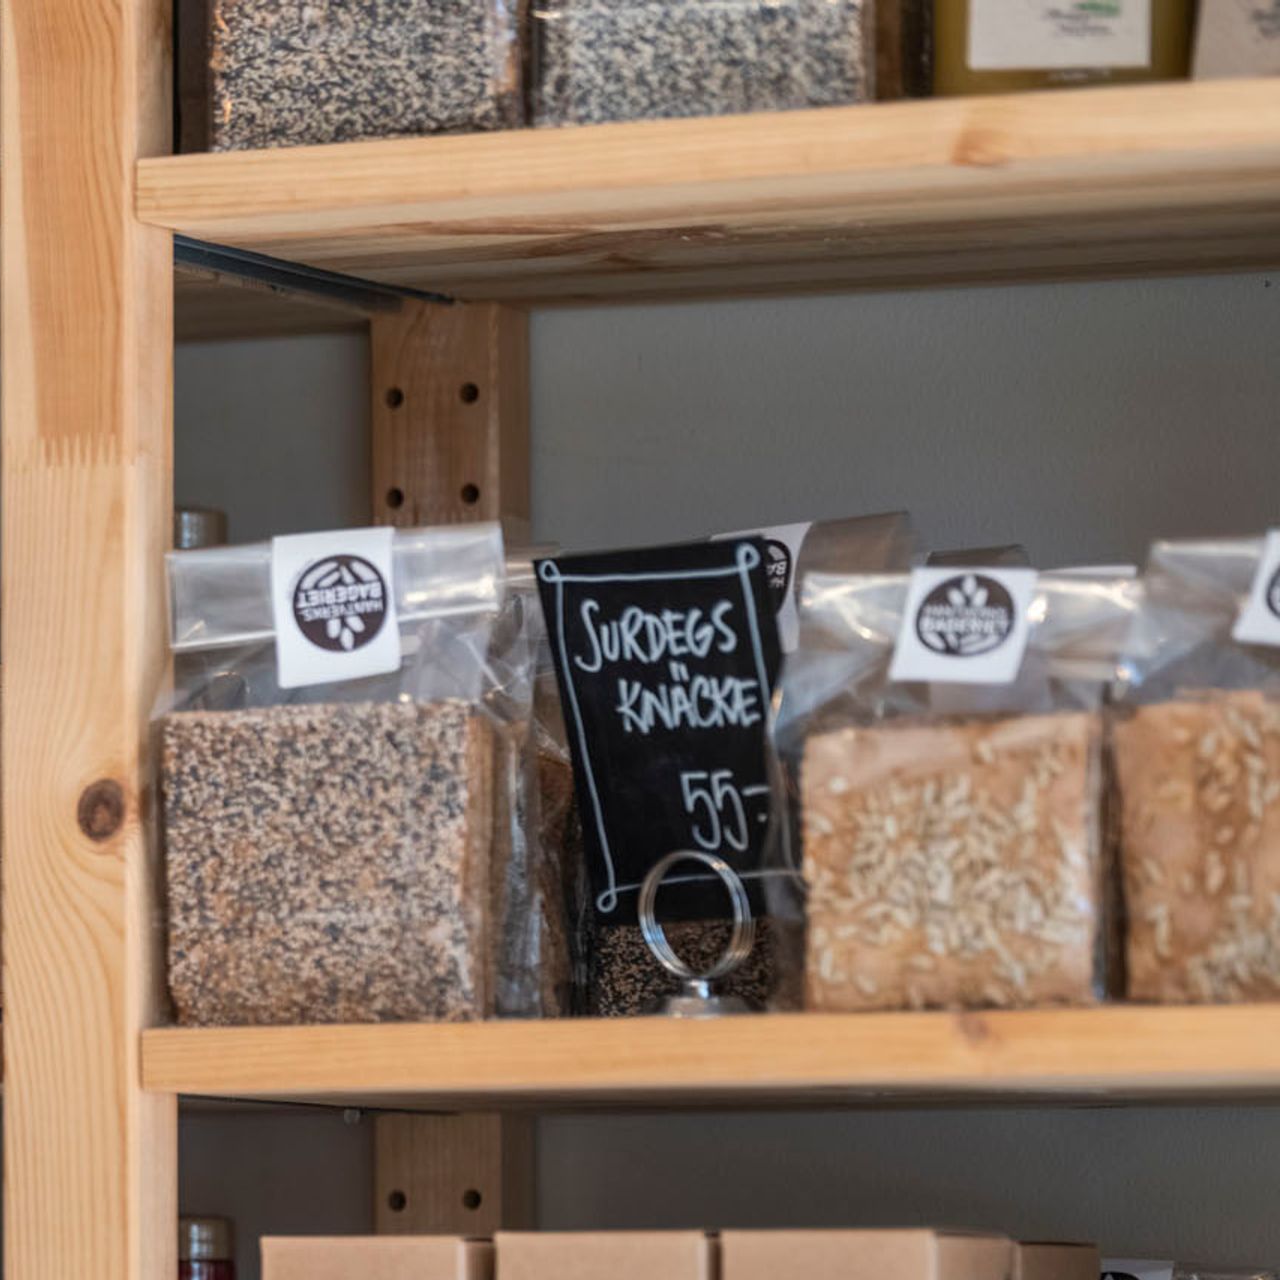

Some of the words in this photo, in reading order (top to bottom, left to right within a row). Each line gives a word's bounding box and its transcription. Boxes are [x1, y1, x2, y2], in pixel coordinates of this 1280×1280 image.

[297, 580, 382, 607] BAGERIET
[574, 598, 738, 673] SURDEGS
[617, 661, 763, 734] KNÄCKE
